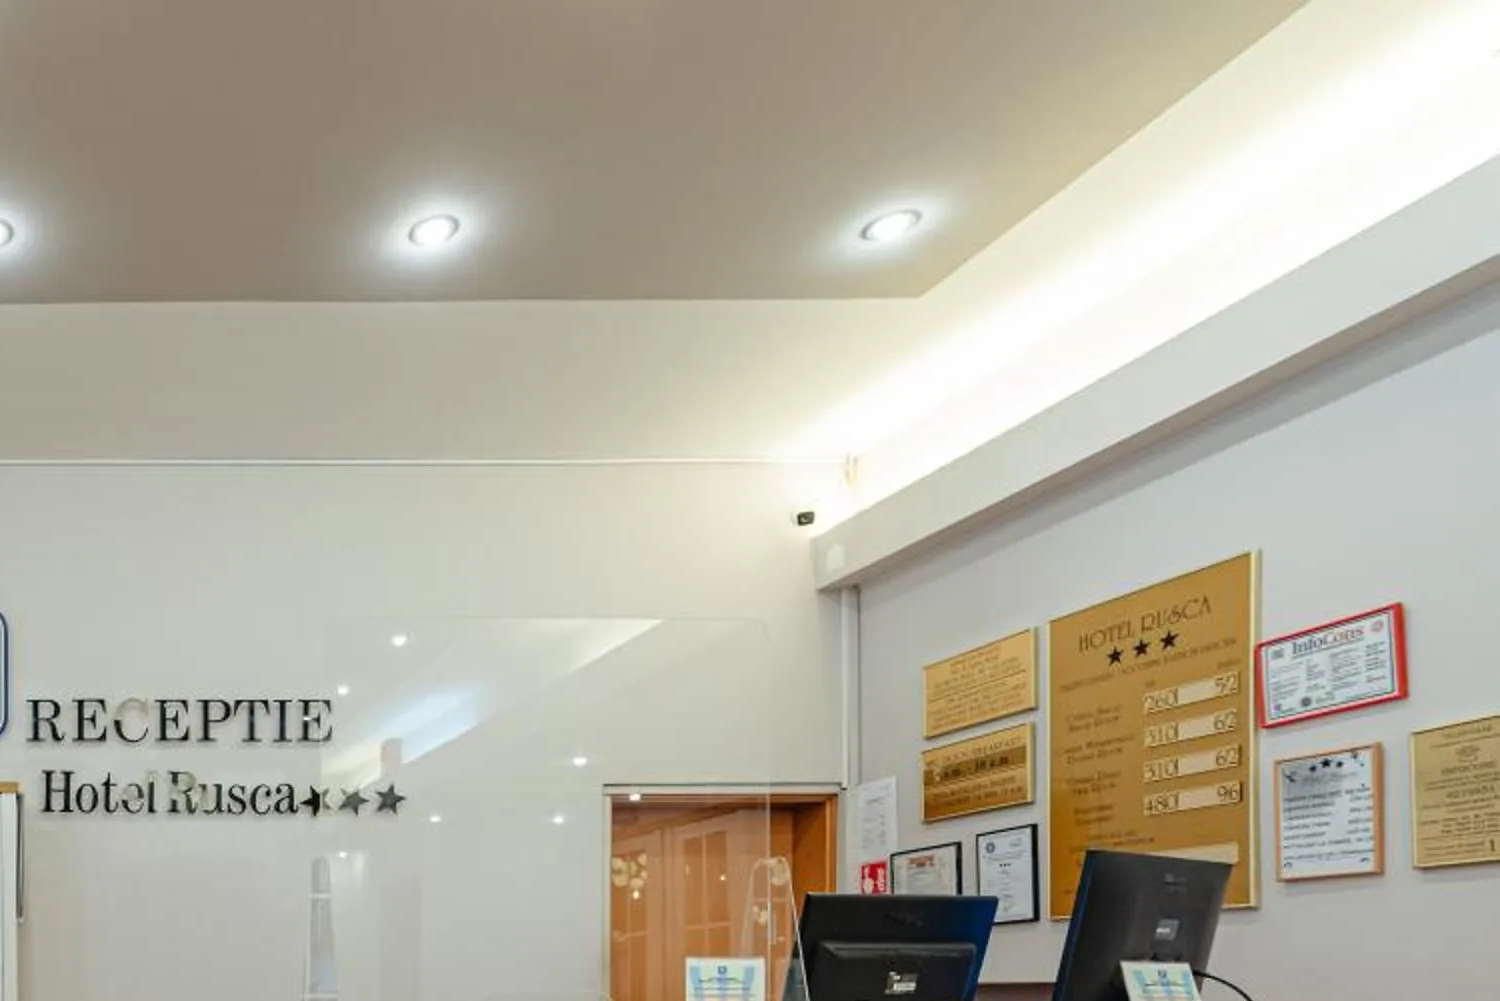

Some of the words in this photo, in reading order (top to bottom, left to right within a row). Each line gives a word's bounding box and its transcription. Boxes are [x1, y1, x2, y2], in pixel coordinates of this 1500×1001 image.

[1078, 619, 1134, 654] HOTEL
[1141, 596, 1212, 632] RUSCA
[1291, 626, 1365, 655] InfoCons
[1214, 672, 1238, 694] 52
[25, 698, 334, 744] RECEPTIE
[1213, 709, 1237, 732] 62
[1215, 746, 1238, 767] 62
[40, 770, 156, 815] Hotel
[167, 771, 300, 815] Rusca
[1216, 783, 1239, 801] 96
